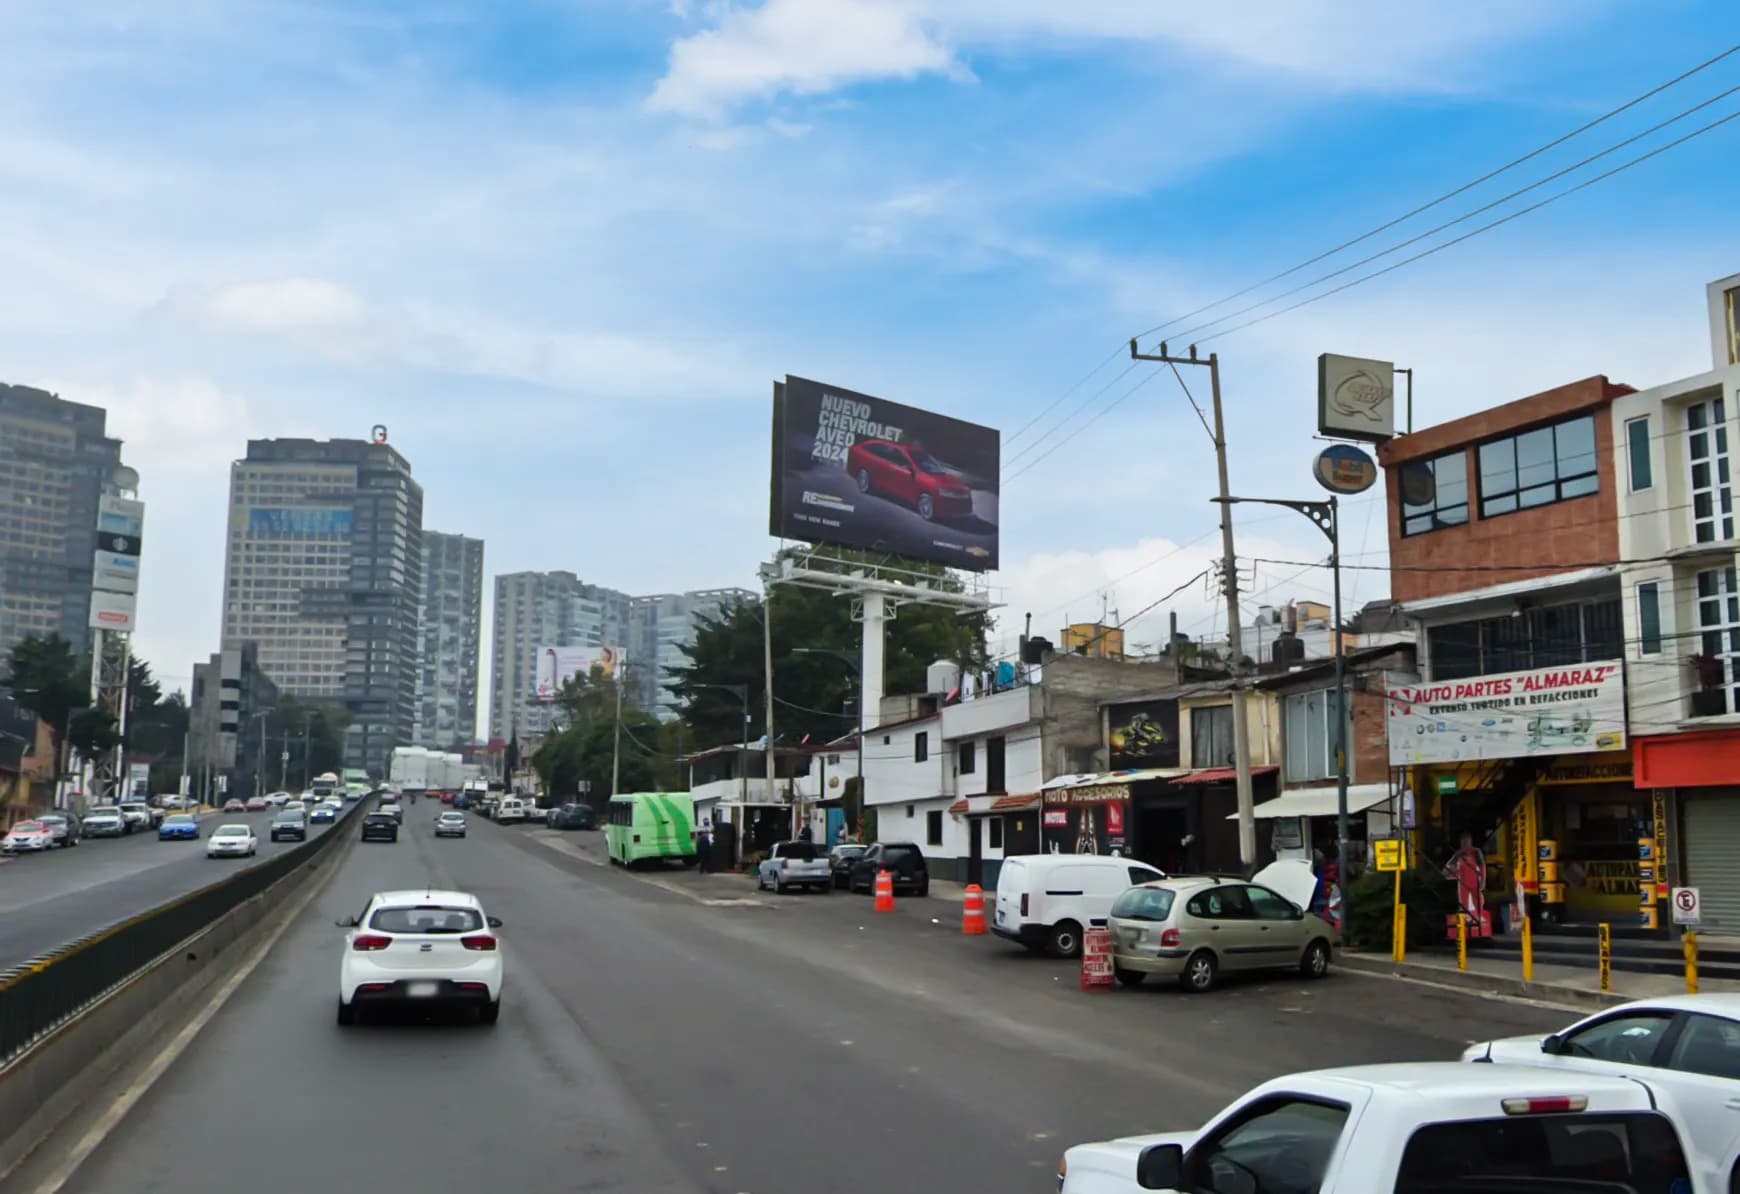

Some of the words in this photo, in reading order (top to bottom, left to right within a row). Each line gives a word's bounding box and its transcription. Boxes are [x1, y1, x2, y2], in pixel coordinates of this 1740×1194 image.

[821, 393, 871, 419] NUEVO
[816, 425, 855, 447] AVEO
[818, 410, 903, 442] CHEVROLET
[811, 442, 849, 463] 2024
[1414, 686, 1452, 704] AUTO
[1455, 678, 1512, 699] PARTES
[1514, 697, 1526, 706] EN
[1530, 688, 1599, 705] REFACCIONES
[1044, 789, 1068, 803] MOTO
[1071, 784, 1130, 801] ACCESORIOS
